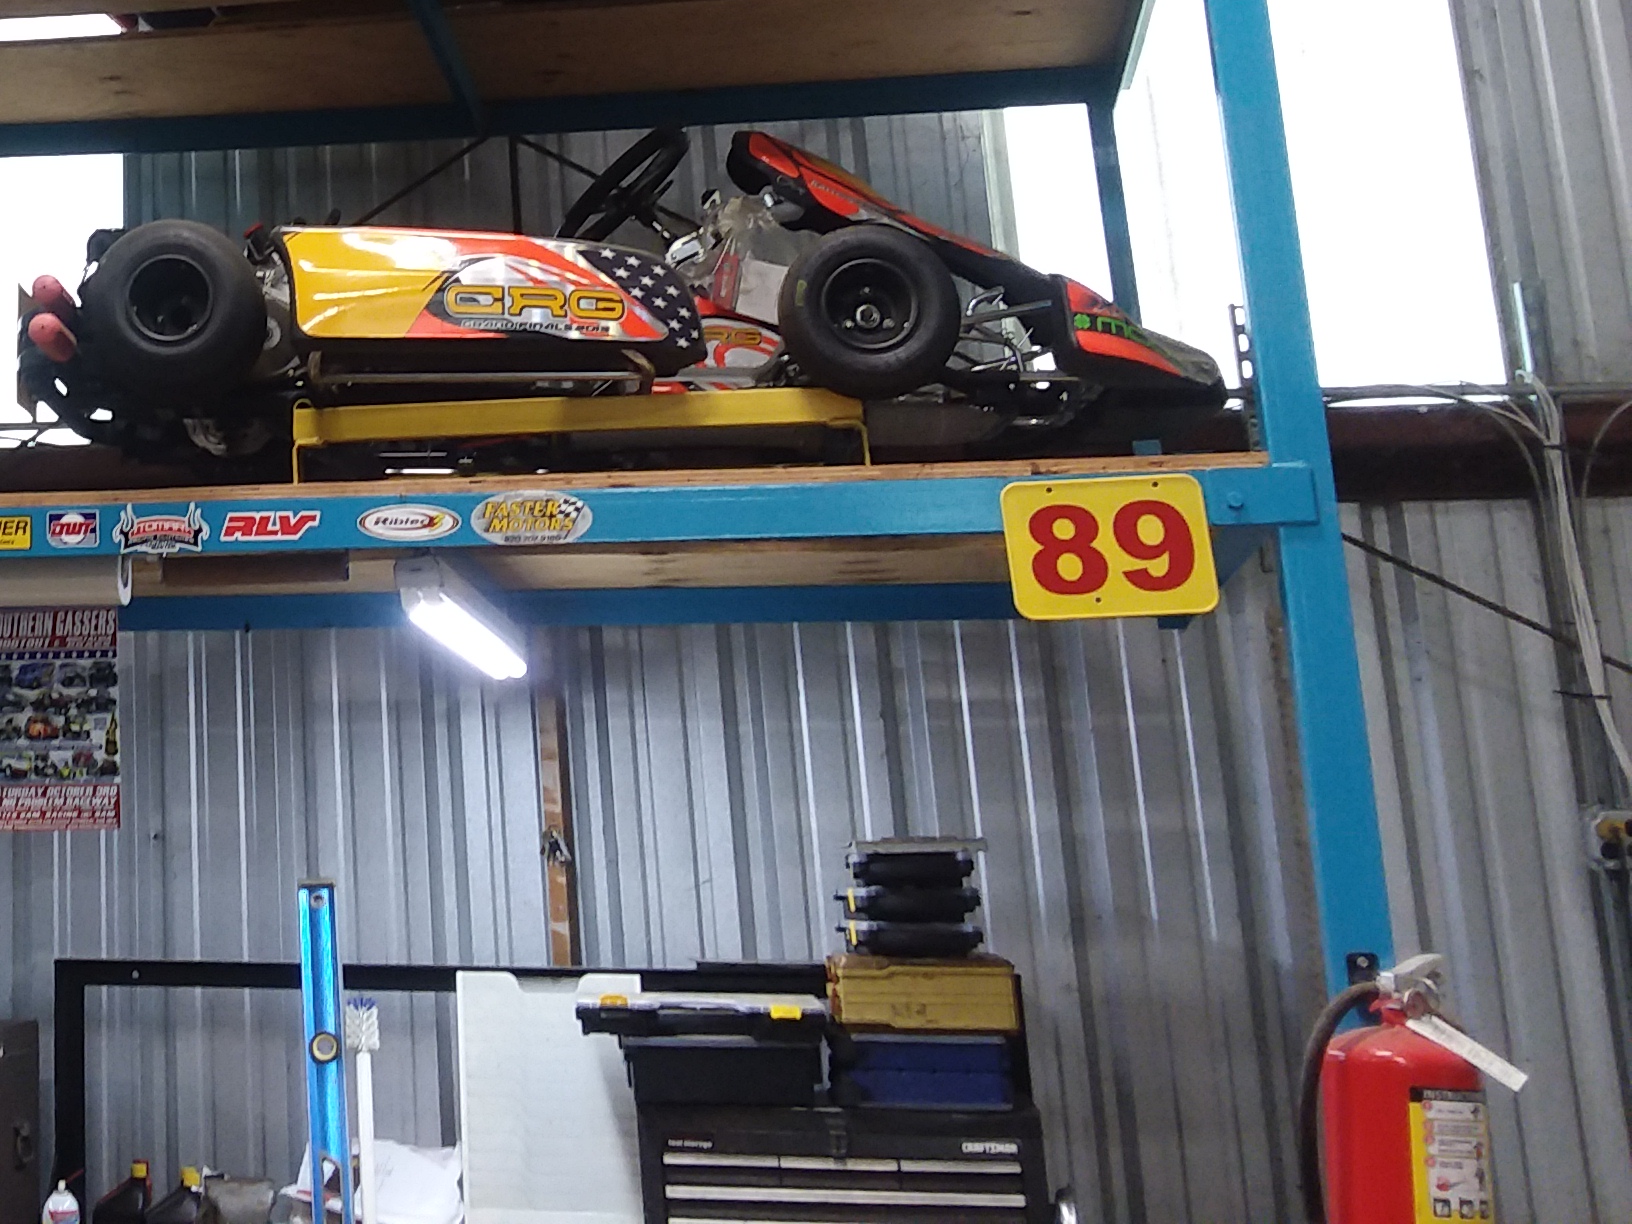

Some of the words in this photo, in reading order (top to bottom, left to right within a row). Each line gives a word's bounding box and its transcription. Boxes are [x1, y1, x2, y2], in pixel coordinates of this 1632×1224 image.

[445, 283, 625, 320] CRG
[703, 326, 762, 347] RG
[483, 500, 559, 519] FASTER
[222, 511, 319, 538] RLV
[487, 517, 573, 534] MOTORS
[1027, 499, 1196, 596] 89
[55, 609, 116, 636] GASSERS
